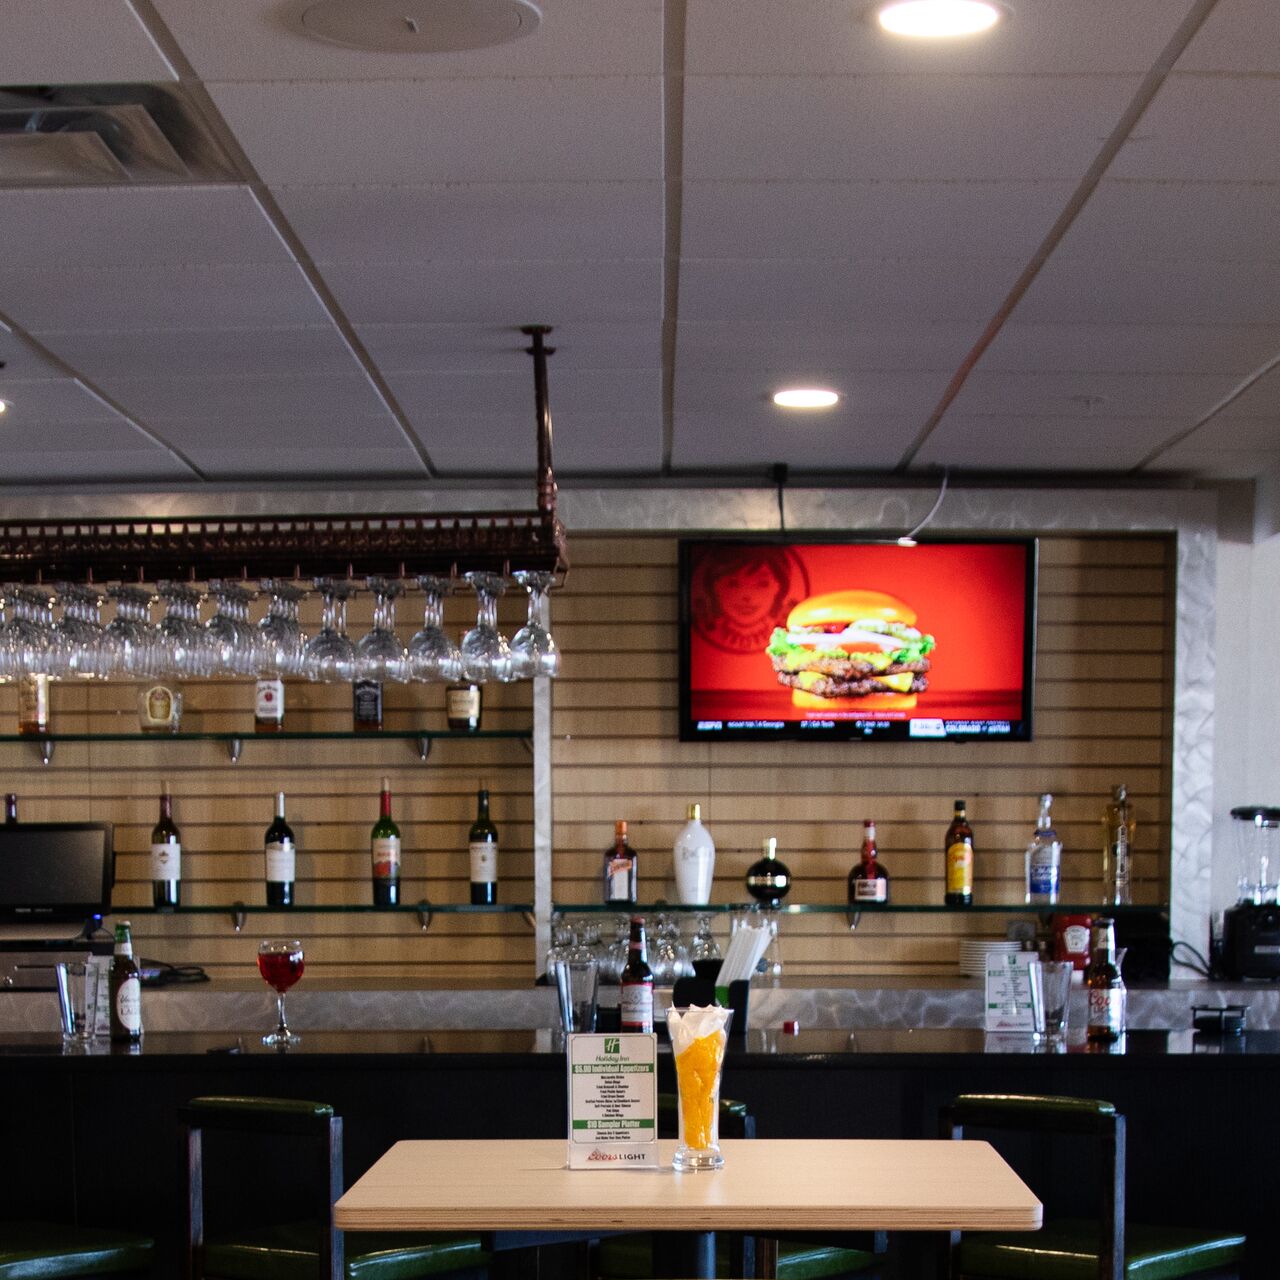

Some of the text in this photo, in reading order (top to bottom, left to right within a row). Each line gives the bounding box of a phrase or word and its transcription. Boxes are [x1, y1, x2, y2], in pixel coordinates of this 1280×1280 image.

[595, 1055, 619, 1063] Holiday
[575, 1064, 650, 1073] $5.00 Individual Appetizers
[587, 1120, 640, 1129] $10 Sampler Platter
[586, 1151, 646, 1161] Coors LIGHT
